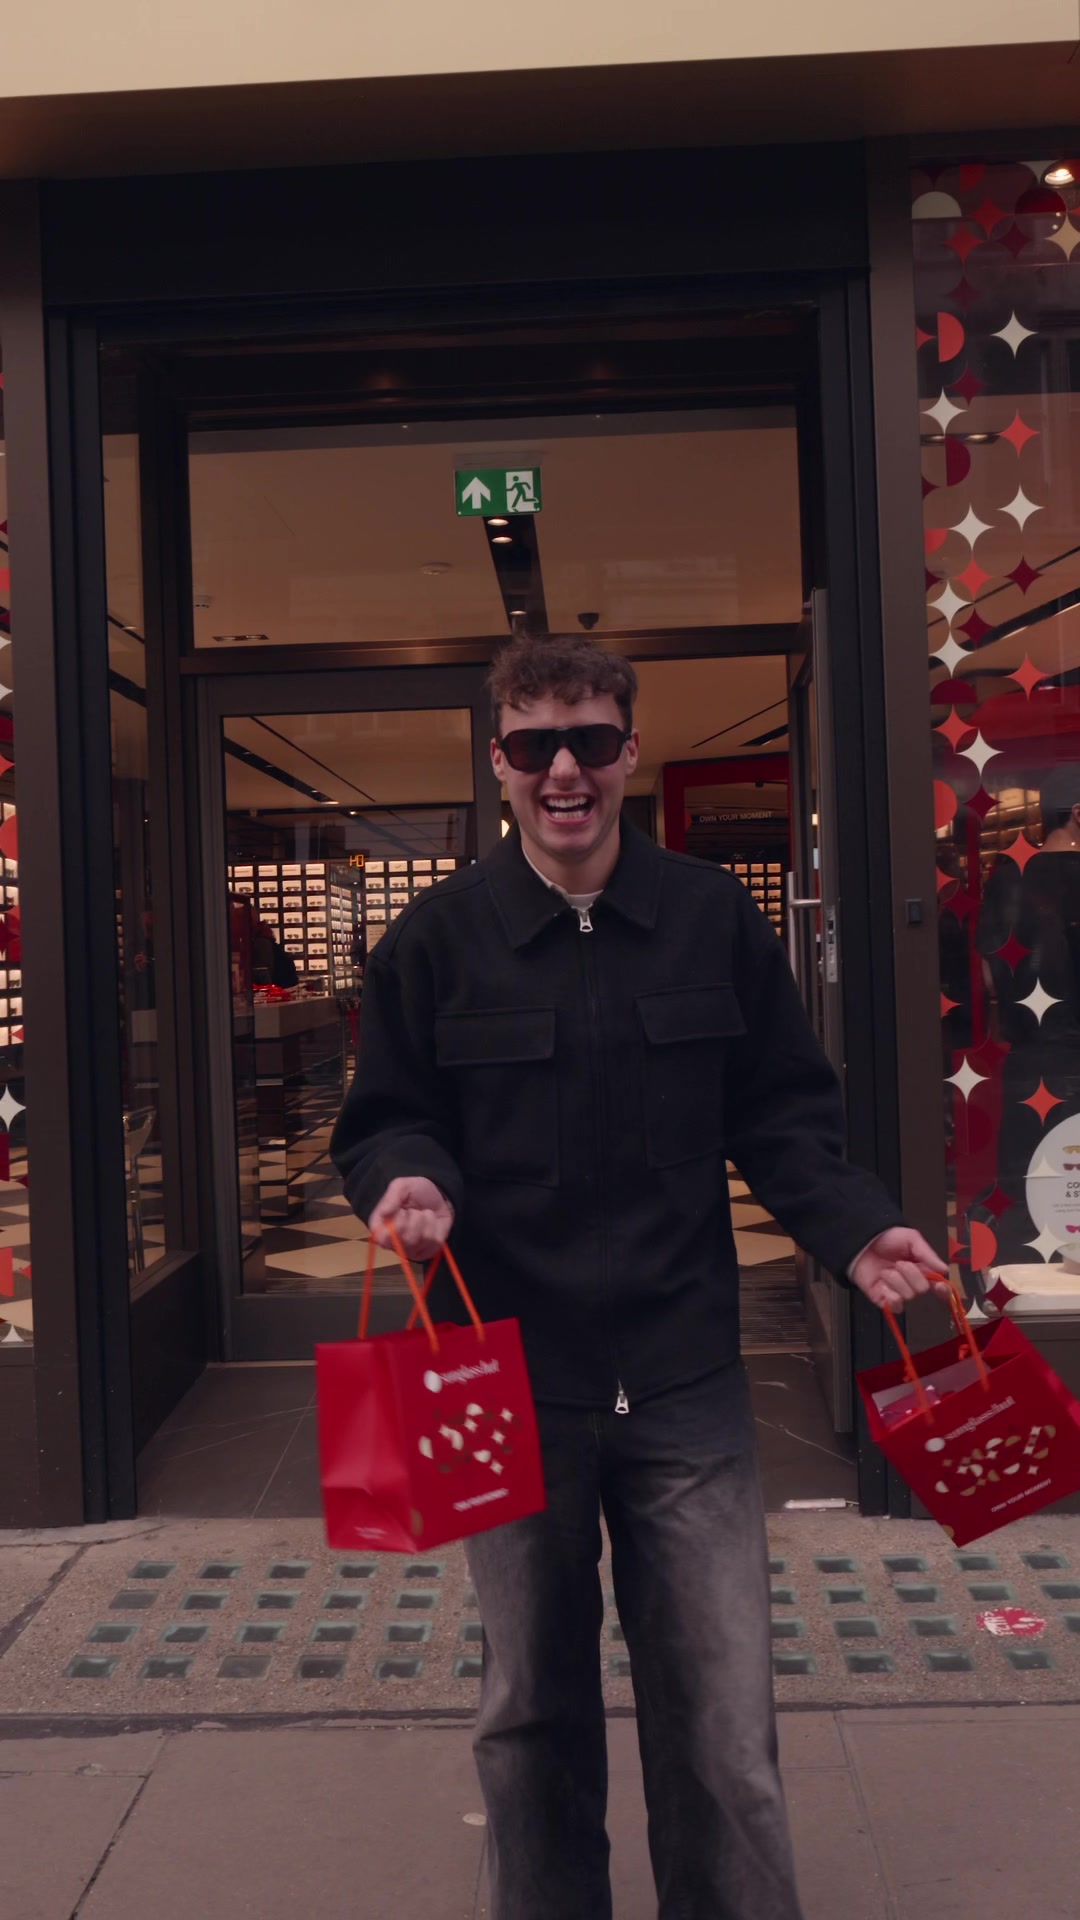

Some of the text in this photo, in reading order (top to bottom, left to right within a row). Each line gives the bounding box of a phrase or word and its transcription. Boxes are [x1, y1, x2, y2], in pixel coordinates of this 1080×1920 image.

[699, 811, 773, 823] OWN YOUR MOMENT
[1066, 1181, 1080, 1189] CO
